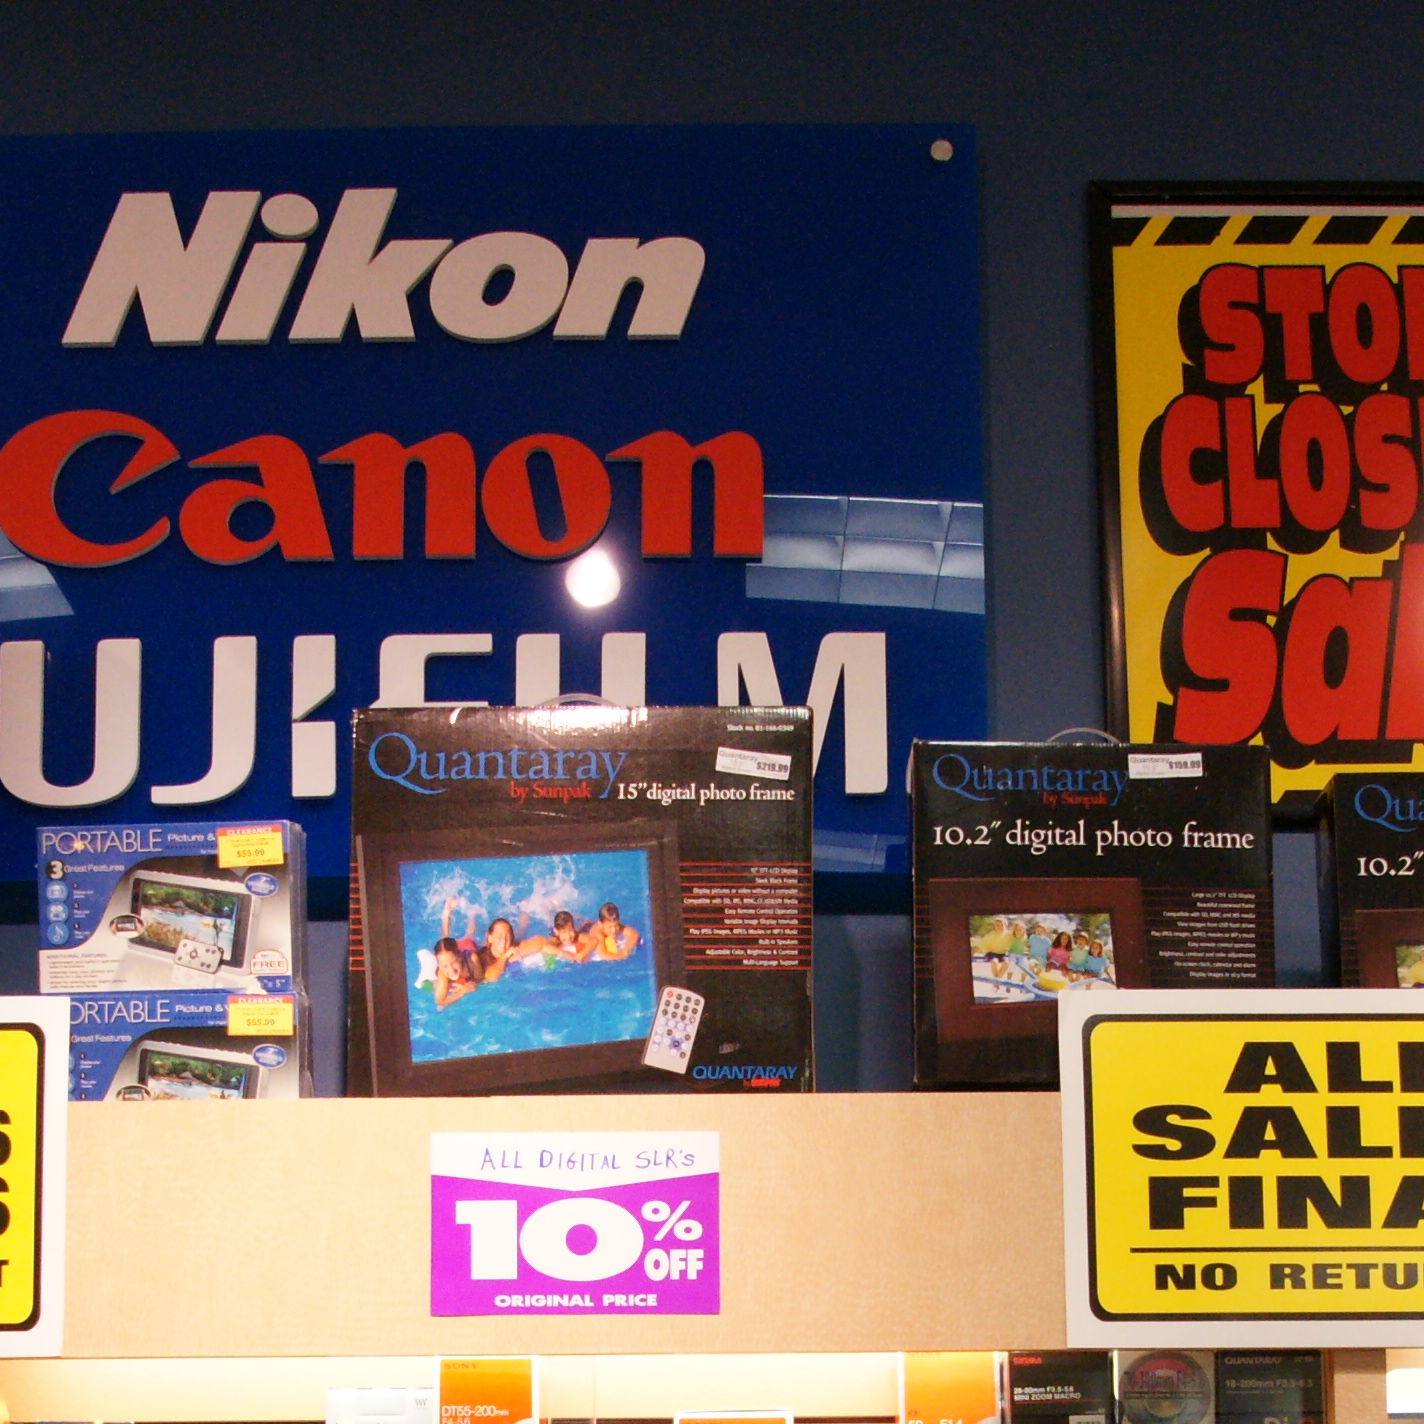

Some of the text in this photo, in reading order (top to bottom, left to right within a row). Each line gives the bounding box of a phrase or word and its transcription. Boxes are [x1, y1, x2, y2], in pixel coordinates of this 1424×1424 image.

[61, 187, 707, 346] Nikon
[368, 732, 628, 799] Quantaray
[510, 782, 592, 802] by Sunpak
[932, 753, 1128, 806] Quantaray
[700, 784, 795, 806] photo frame
[42, 829, 205, 855] PORTABLE Picture
[227, 827, 273, 836] CLEARANCE
[1005, 819, 1254, 856] digital photo frame
[175, 1004, 212, 1014] Picture
[693, 1066, 798, 1081] QUANTARAY
[481, 1148, 523, 1171] ALL
[539, 1149, 621, 1172] DIGITAL
[644, 1248, 704, 1281] OFF
[1154, 1263, 1237, 1291] NO
[494, 1293, 658, 1307] ORIGINAL PRICE
